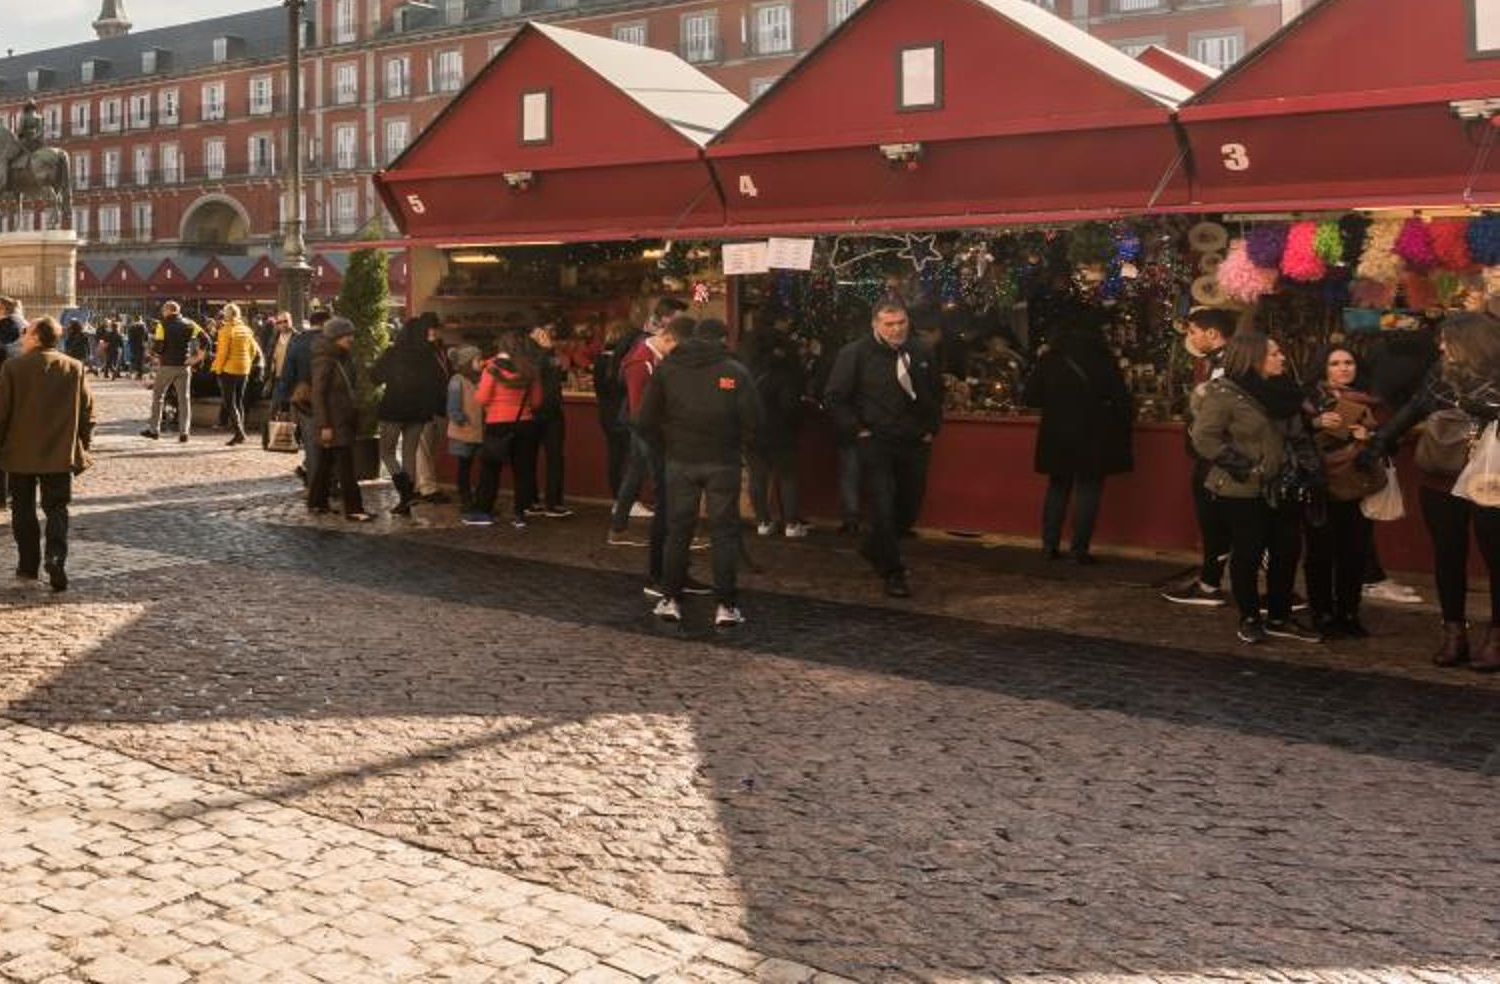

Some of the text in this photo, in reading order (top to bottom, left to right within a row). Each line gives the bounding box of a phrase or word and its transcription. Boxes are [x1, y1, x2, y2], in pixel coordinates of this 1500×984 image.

[1221, 143, 1249, 171] 3
[739, 175, 757, 197] 4
[407, 194, 425, 214] 5
